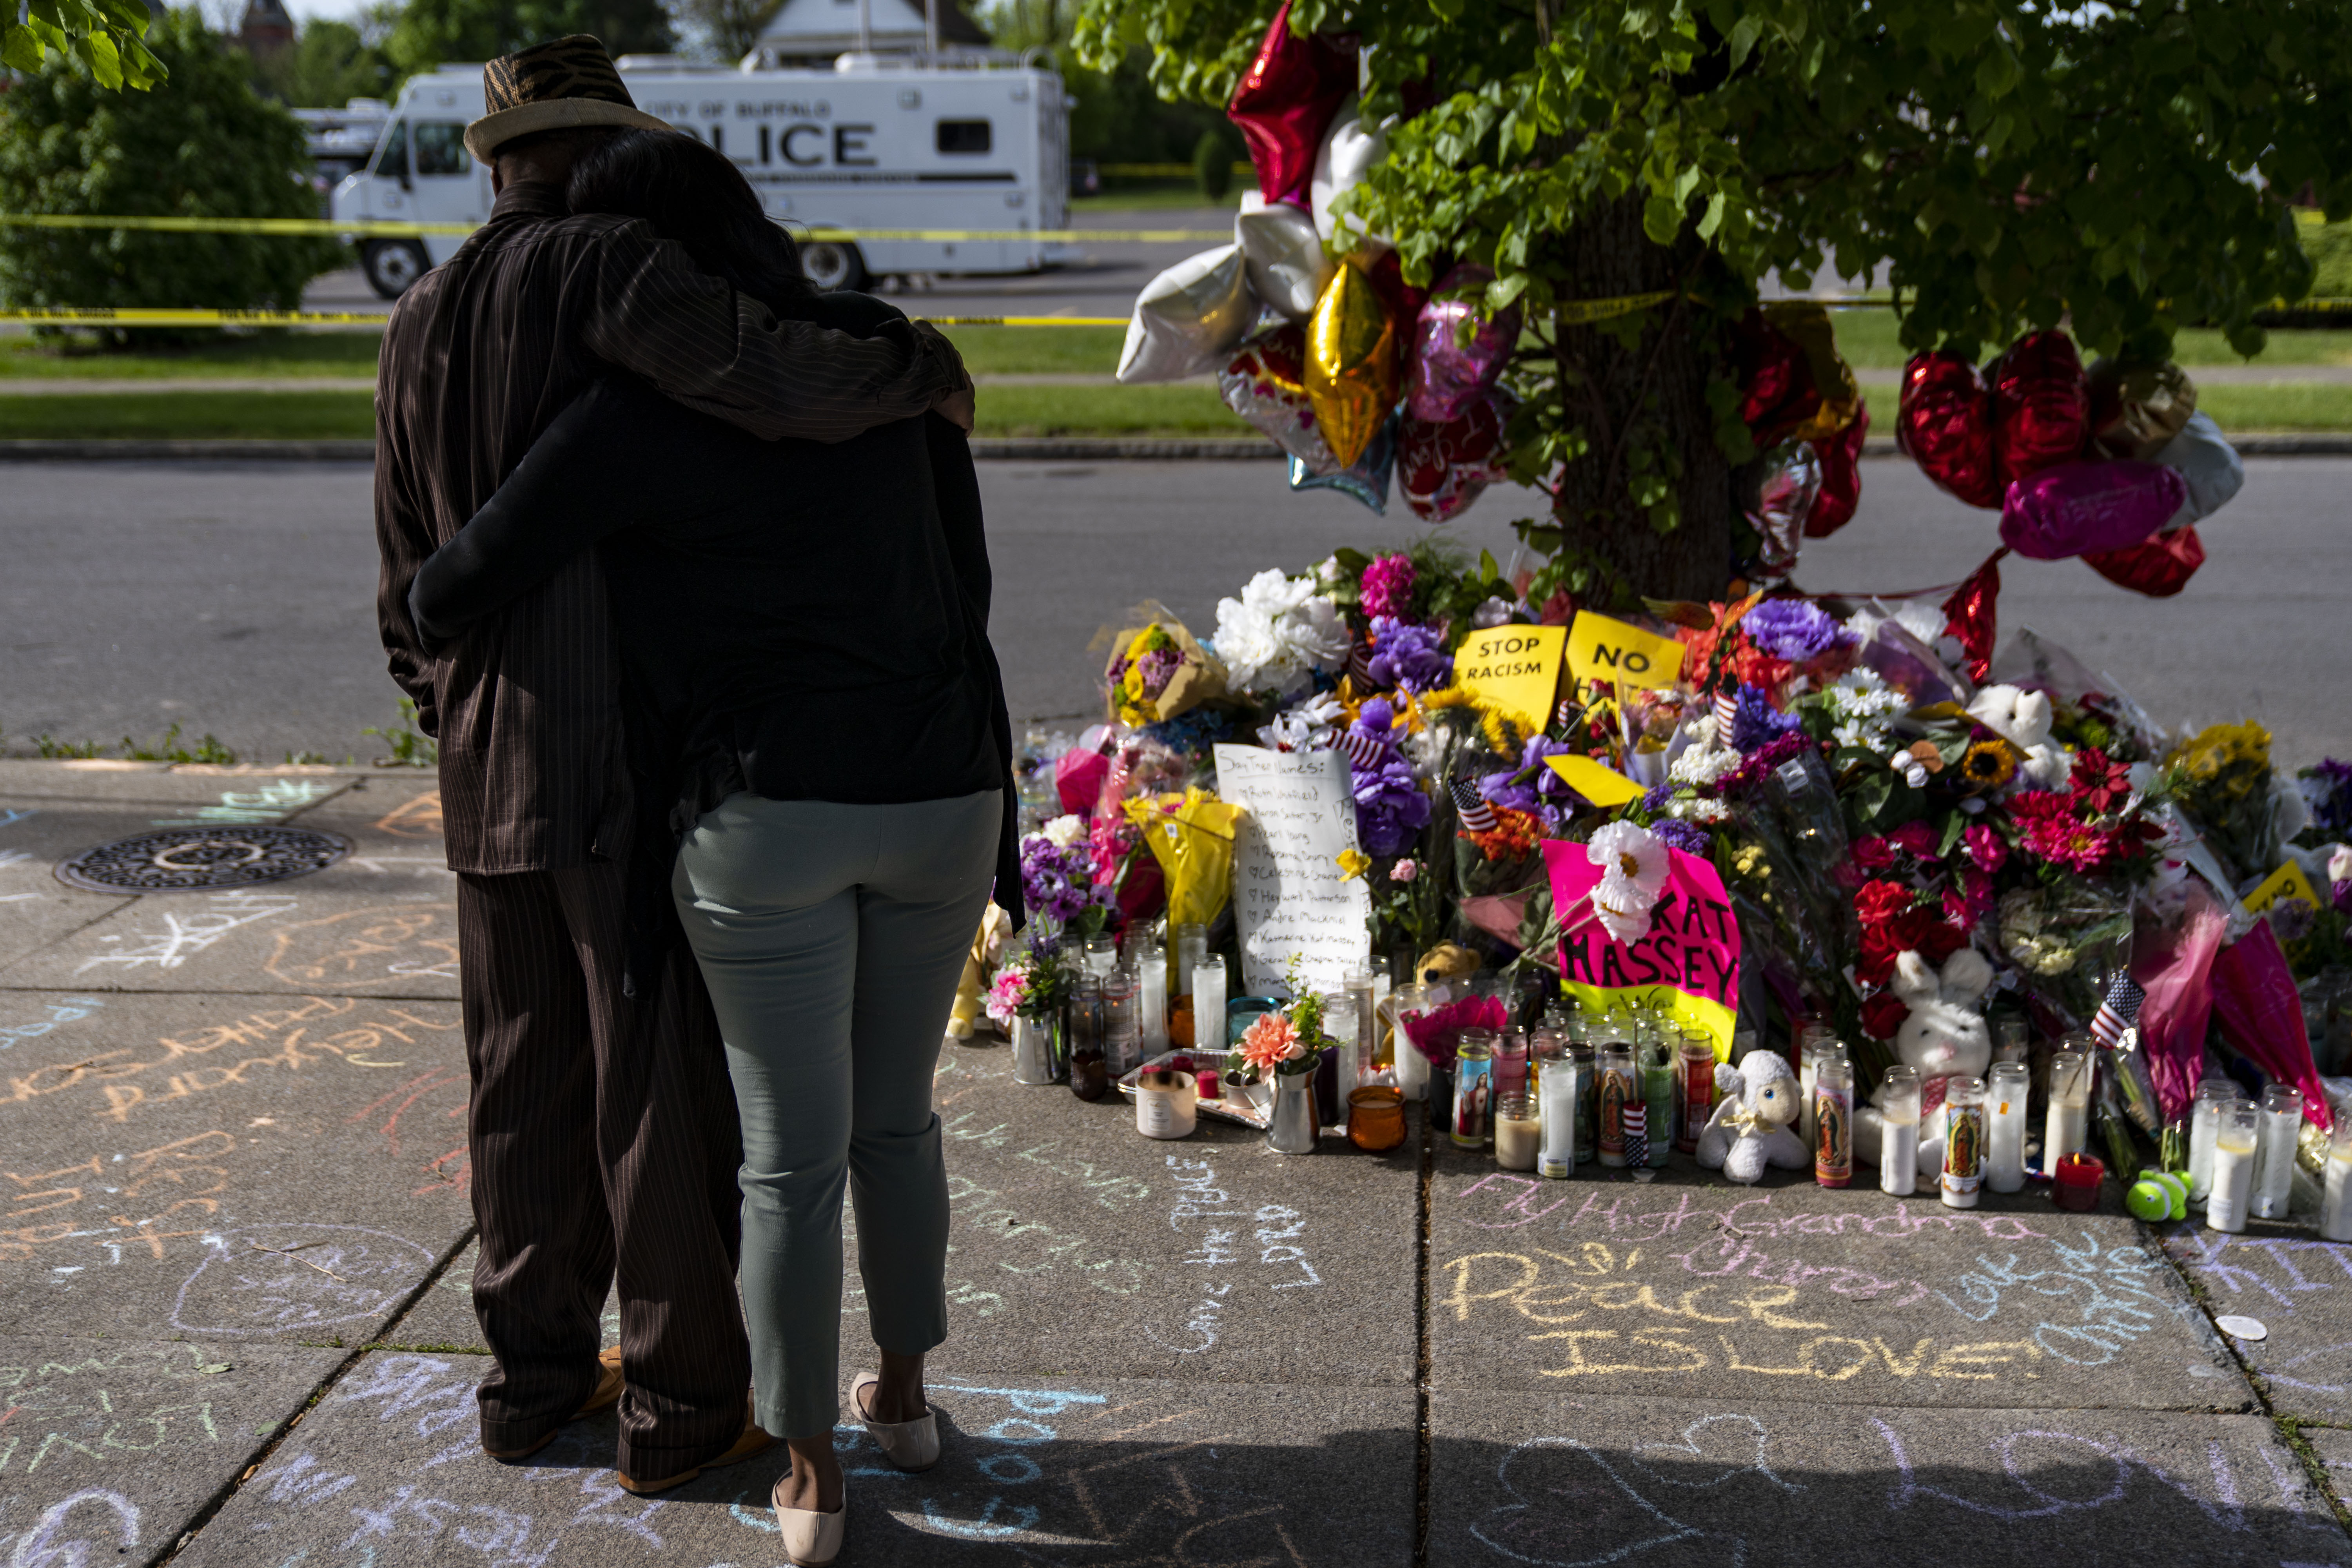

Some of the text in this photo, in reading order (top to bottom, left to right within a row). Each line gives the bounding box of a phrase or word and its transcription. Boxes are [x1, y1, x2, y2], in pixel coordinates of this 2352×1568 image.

[699, 99, 727, 118] OF
[735, 99, 831, 118] BUFFALO
[1479, 637, 1540, 658] STOP
[1592, 644, 1650, 672] NO
[1467, 662, 1541, 680] RACISM
[1218, 750, 1248, 773] Say
[1274, 760, 1325, 775] Names:
[1256, 823, 1283, 840] Pearl
[1334, 796, 1356, 849] Rest
[1263, 908, 1295, 924] Andre
[1650, 890, 1730, 943] KAT
[1561, 935, 1737, 1002] MASSEY
[1452, 1172, 2047, 1242] Fly High Grandma
[1439, 1252, 1829, 1329] Peace
